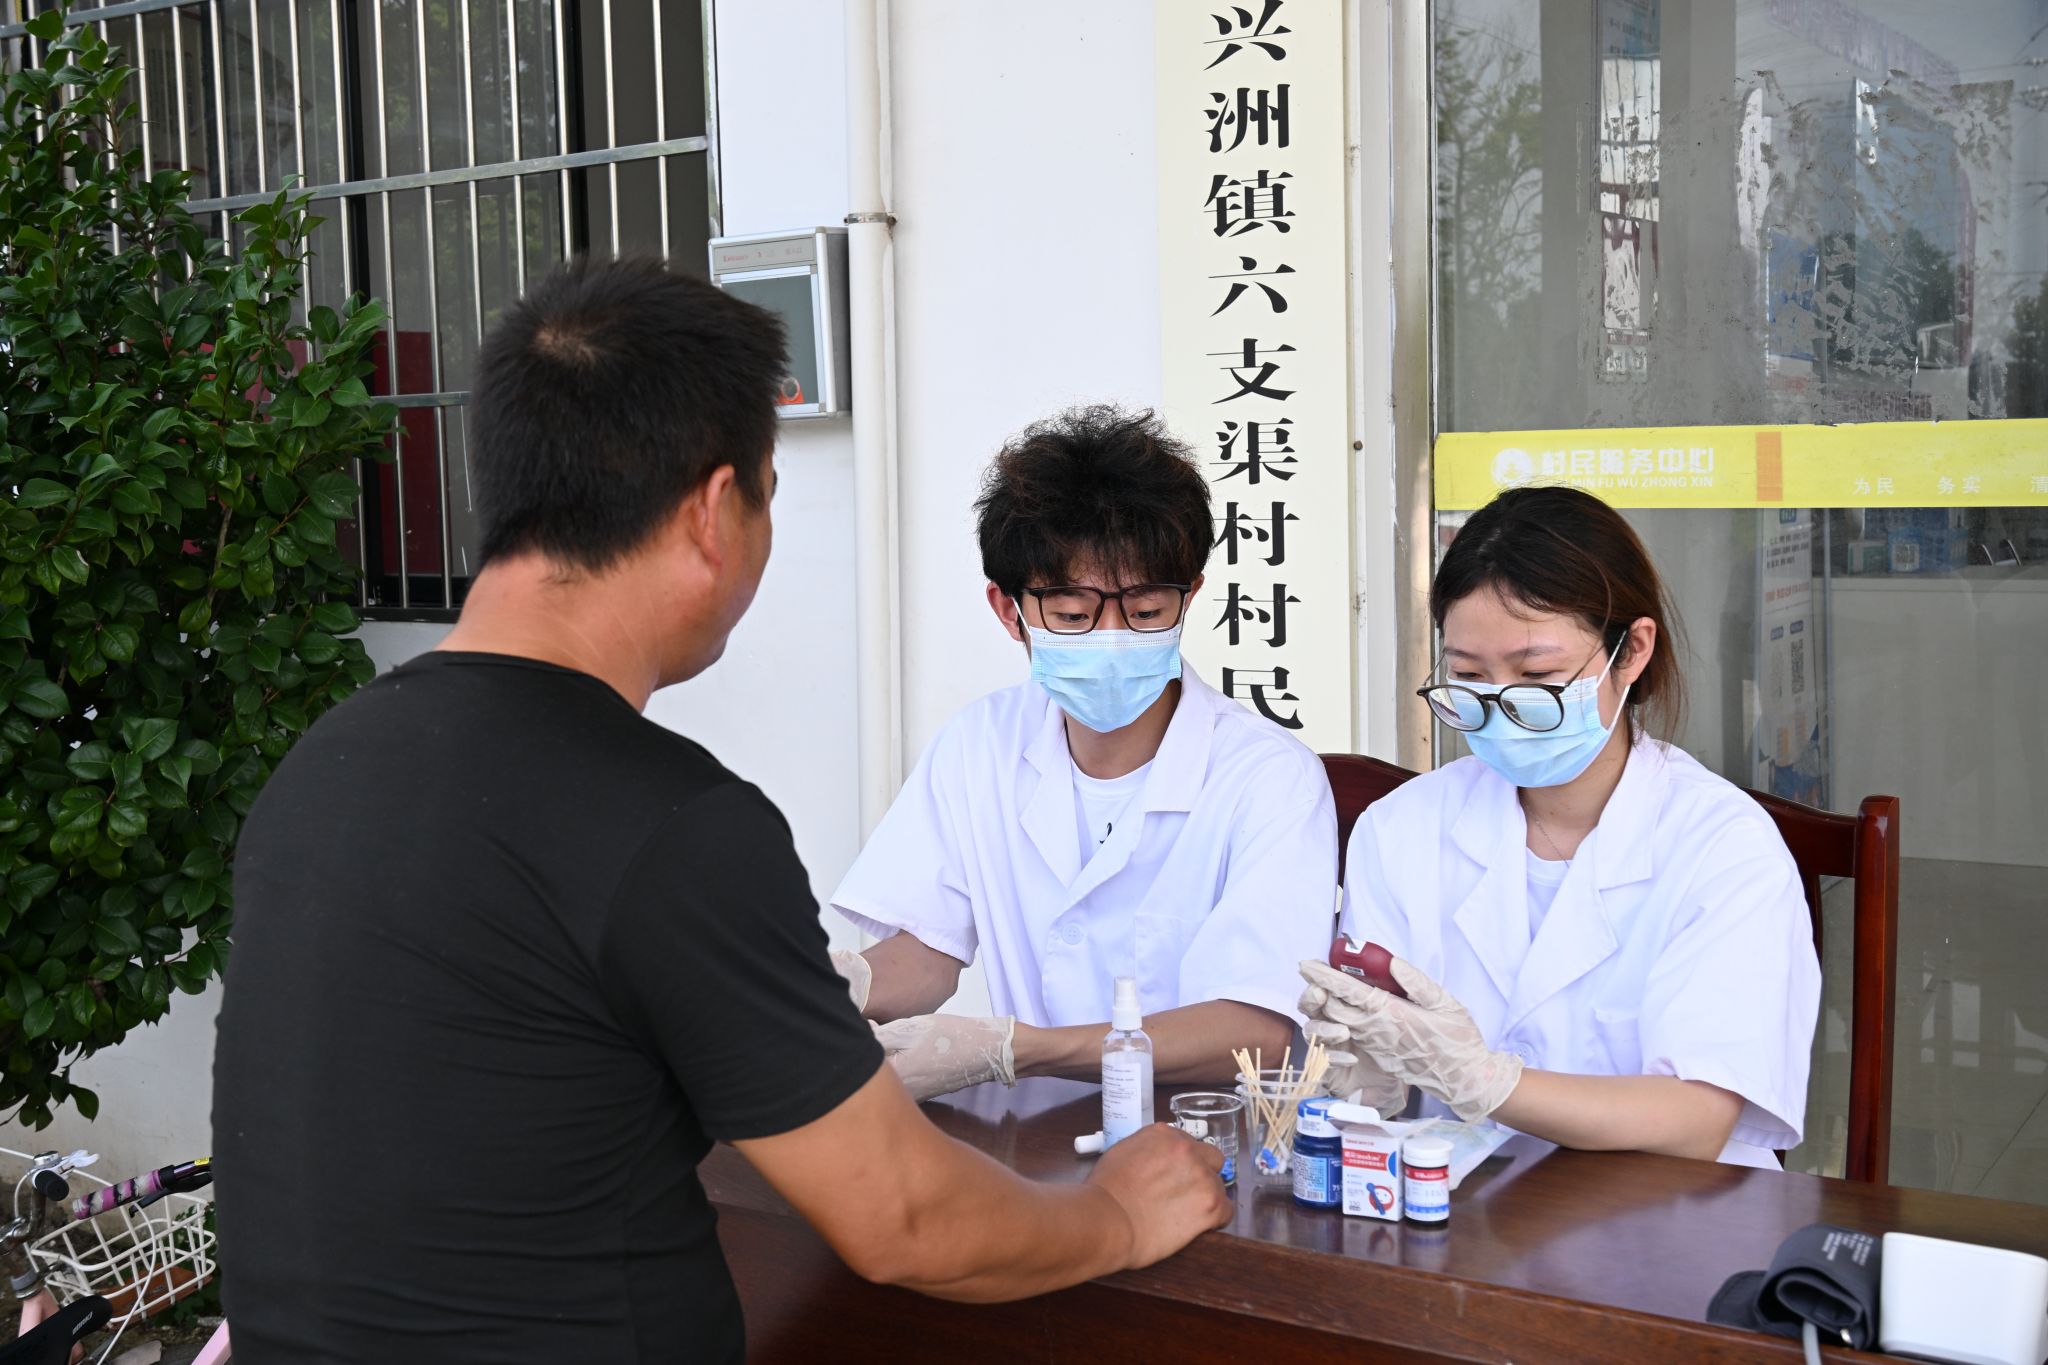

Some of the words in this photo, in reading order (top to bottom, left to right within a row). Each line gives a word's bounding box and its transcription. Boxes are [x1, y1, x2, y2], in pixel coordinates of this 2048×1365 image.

[1203, 0, 1304, 730] 兴洲镇六支渠村村民
[1542, 447, 1714, 475] 村民服务中心
[1617, 477, 1638, 488] WU
[1641, 476, 1687, 488] ZHONG
[1691, 475, 1713, 487] XIN
[1853, 477, 1895, 495] 为民
[1937, 475, 1981, 494] 务实
